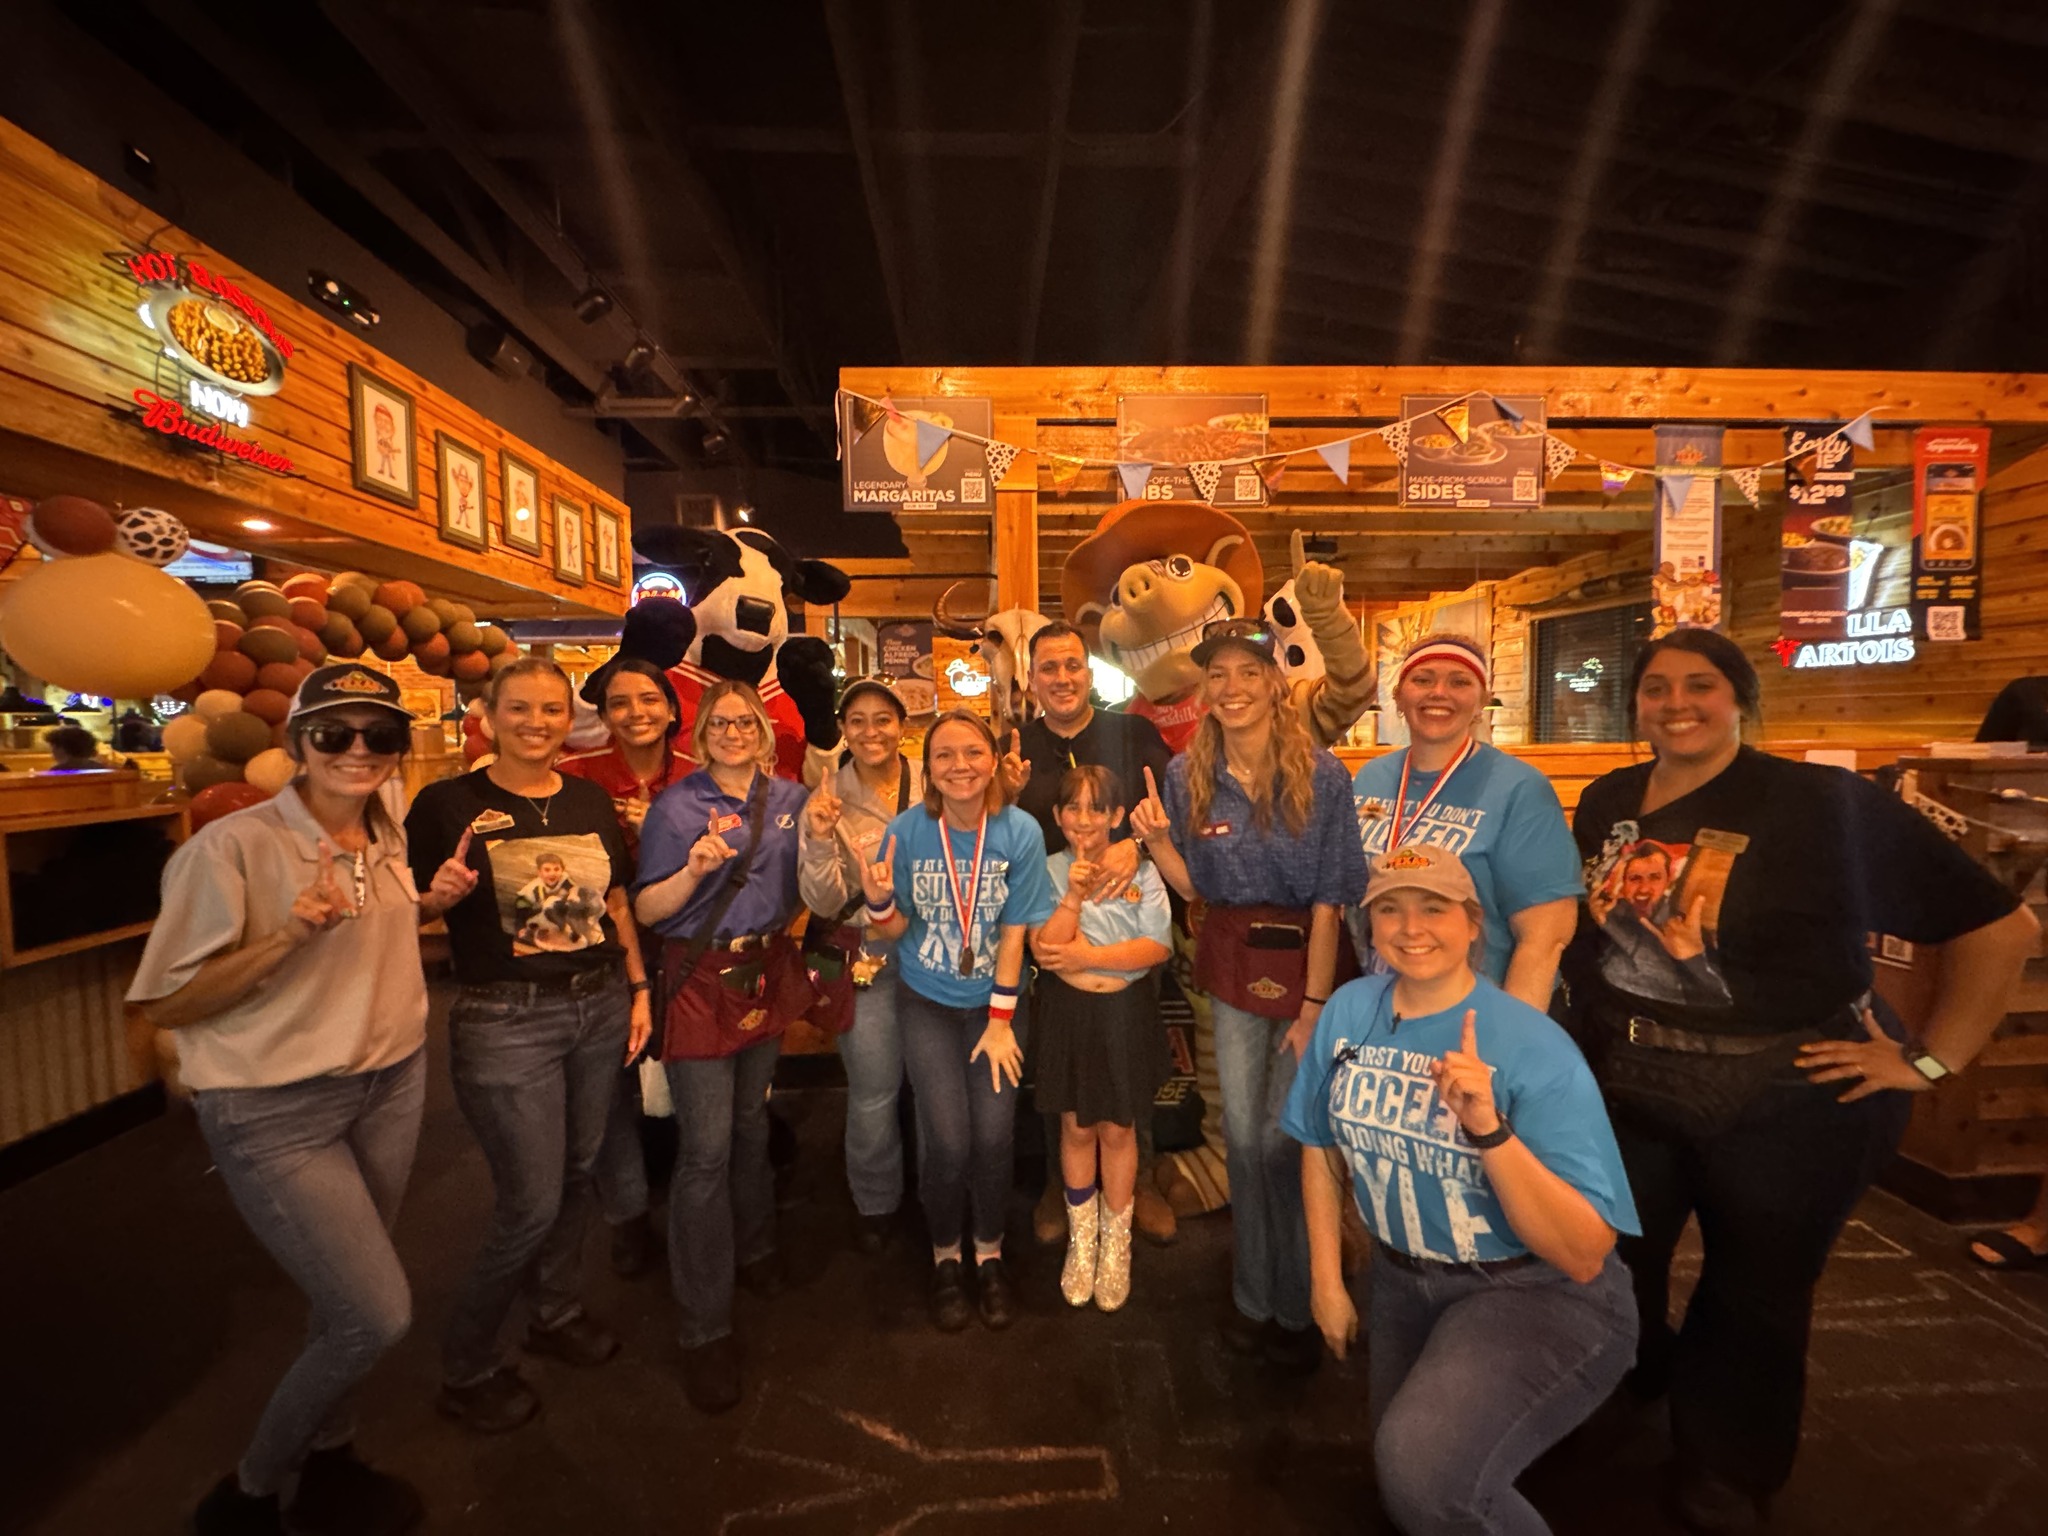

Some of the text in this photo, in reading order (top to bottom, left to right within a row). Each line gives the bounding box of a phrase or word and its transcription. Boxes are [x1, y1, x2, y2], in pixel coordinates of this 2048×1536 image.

[127, 253, 294, 359] HOT BLOSSOMS
[190, 379, 249, 428] NOW
[133, 388, 295, 472] Budweiser
[1788, 431, 1851, 463] Early
[854, 481, 905, 489] LEGENDARY
[1146, 476, 1194, 486] -OFF-THE-
[1408, 475, 1507, 484] MADE-FROM-SCRATCH
[854, 490, 955, 502] MARGARITAS
[1141, 485, 1174, 500] IBS
[1408, 484, 1467, 500] SIDES
[1847, 609, 1912, 637] LLA
[1794, 638, 1916, 668] ARTOIS
[1440, 805, 1486, 827] DON'T
[923, 860, 935, 872] AT
[1402, 1050, 1438, 1077] YOU
[1342, 1122, 1410, 1166] DOING
[1413, 1141, 1484, 1188] WHAT
